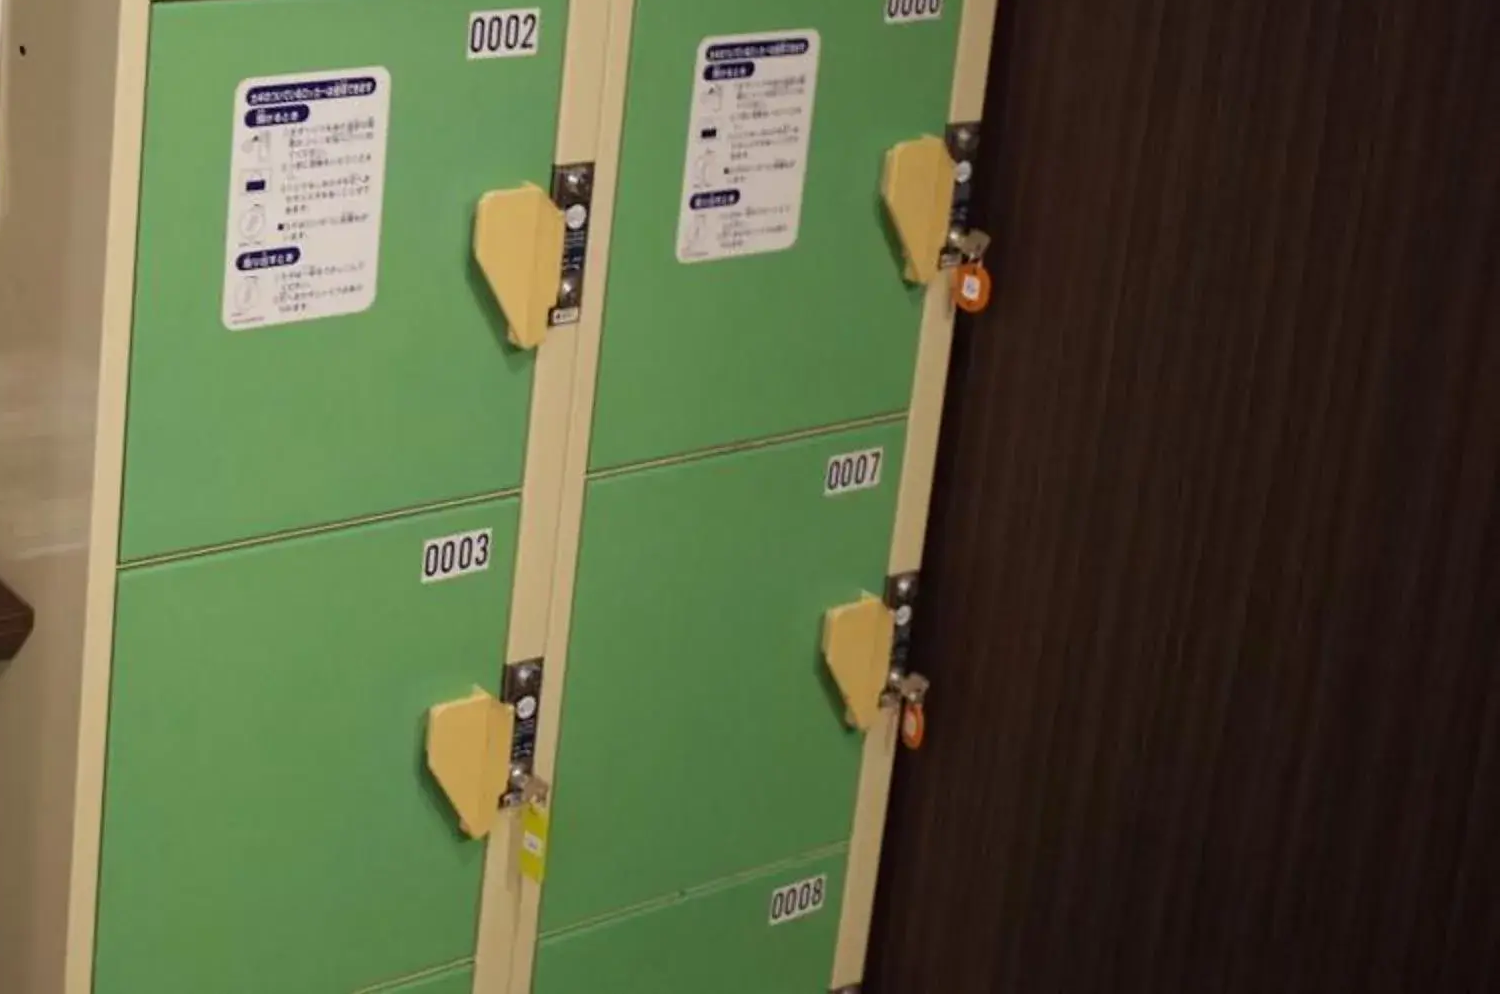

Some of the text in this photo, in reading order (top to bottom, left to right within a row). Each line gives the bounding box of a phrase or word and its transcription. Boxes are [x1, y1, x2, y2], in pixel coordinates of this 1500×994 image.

[471, 13, 536, 53] 0002
[828, 451, 881, 491] 0007
[425, 533, 489, 576] 0003
[772, 877, 822, 920] 0008
